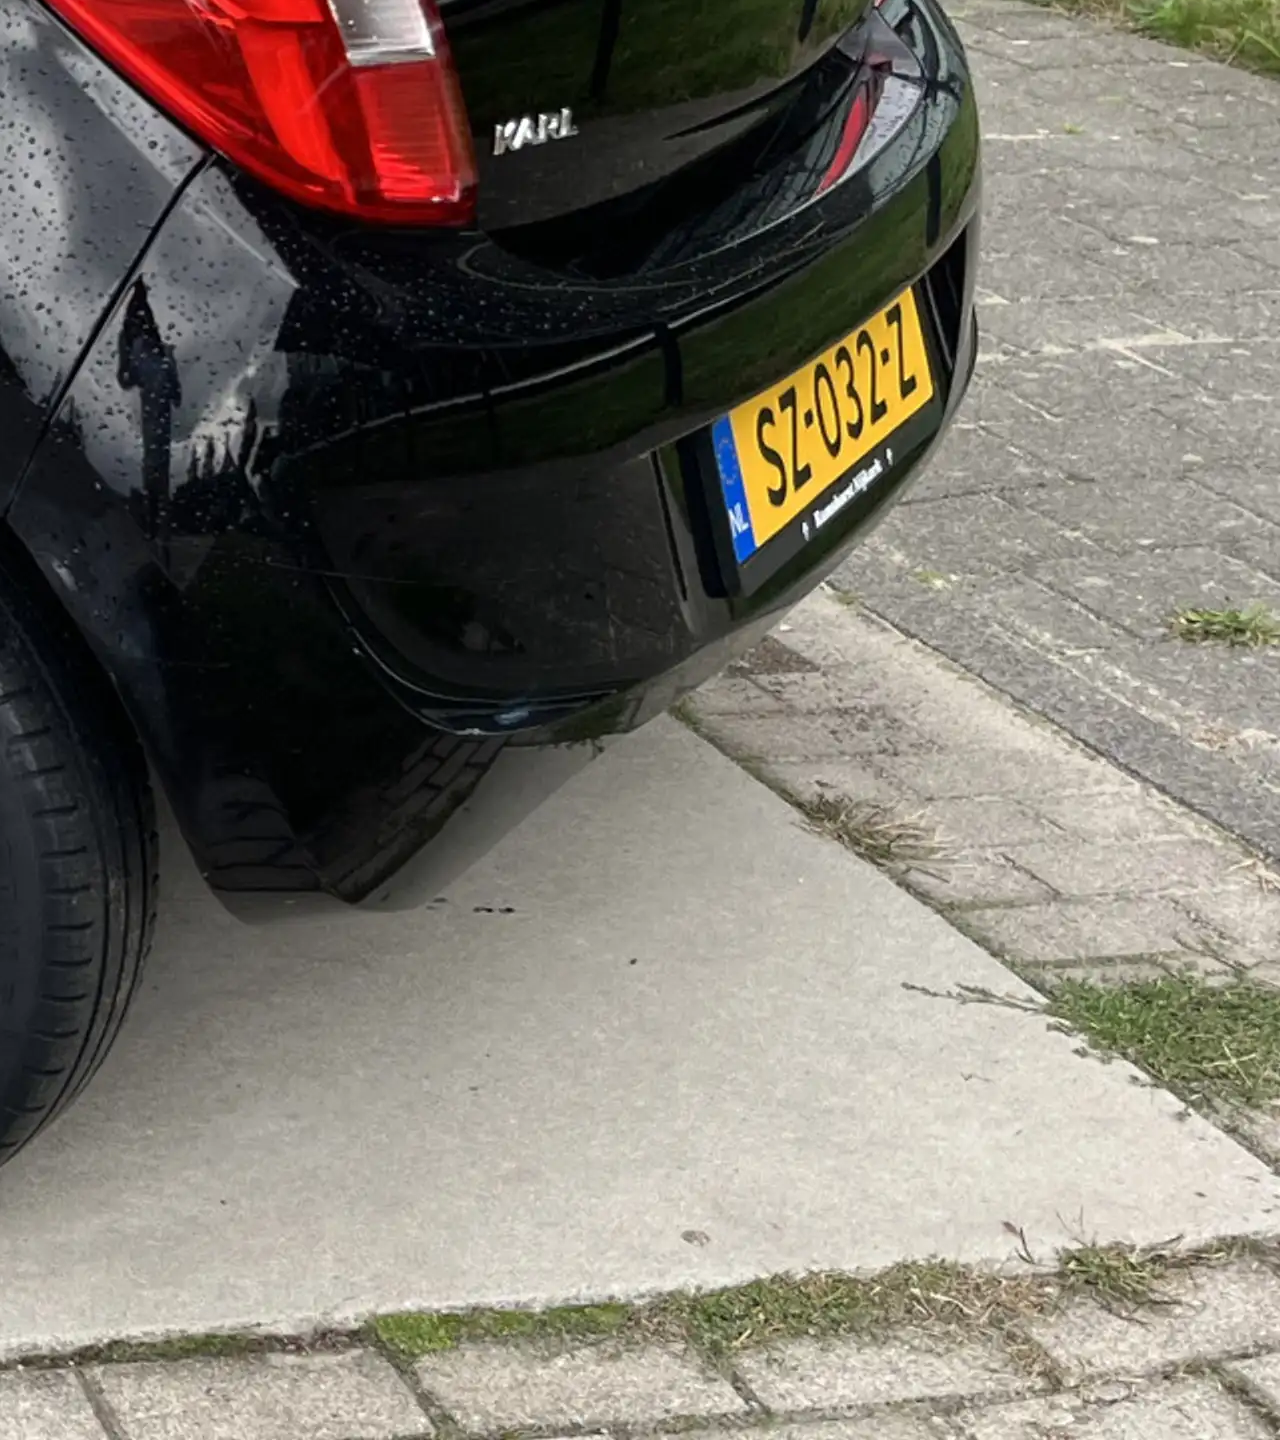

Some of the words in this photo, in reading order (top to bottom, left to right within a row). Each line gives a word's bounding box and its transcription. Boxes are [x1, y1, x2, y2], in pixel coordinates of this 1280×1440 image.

[493, 107, 579, 156] KARL
[755, 303, 917, 509] SZ-032-Z
[727, 502, 749, 537] NL
